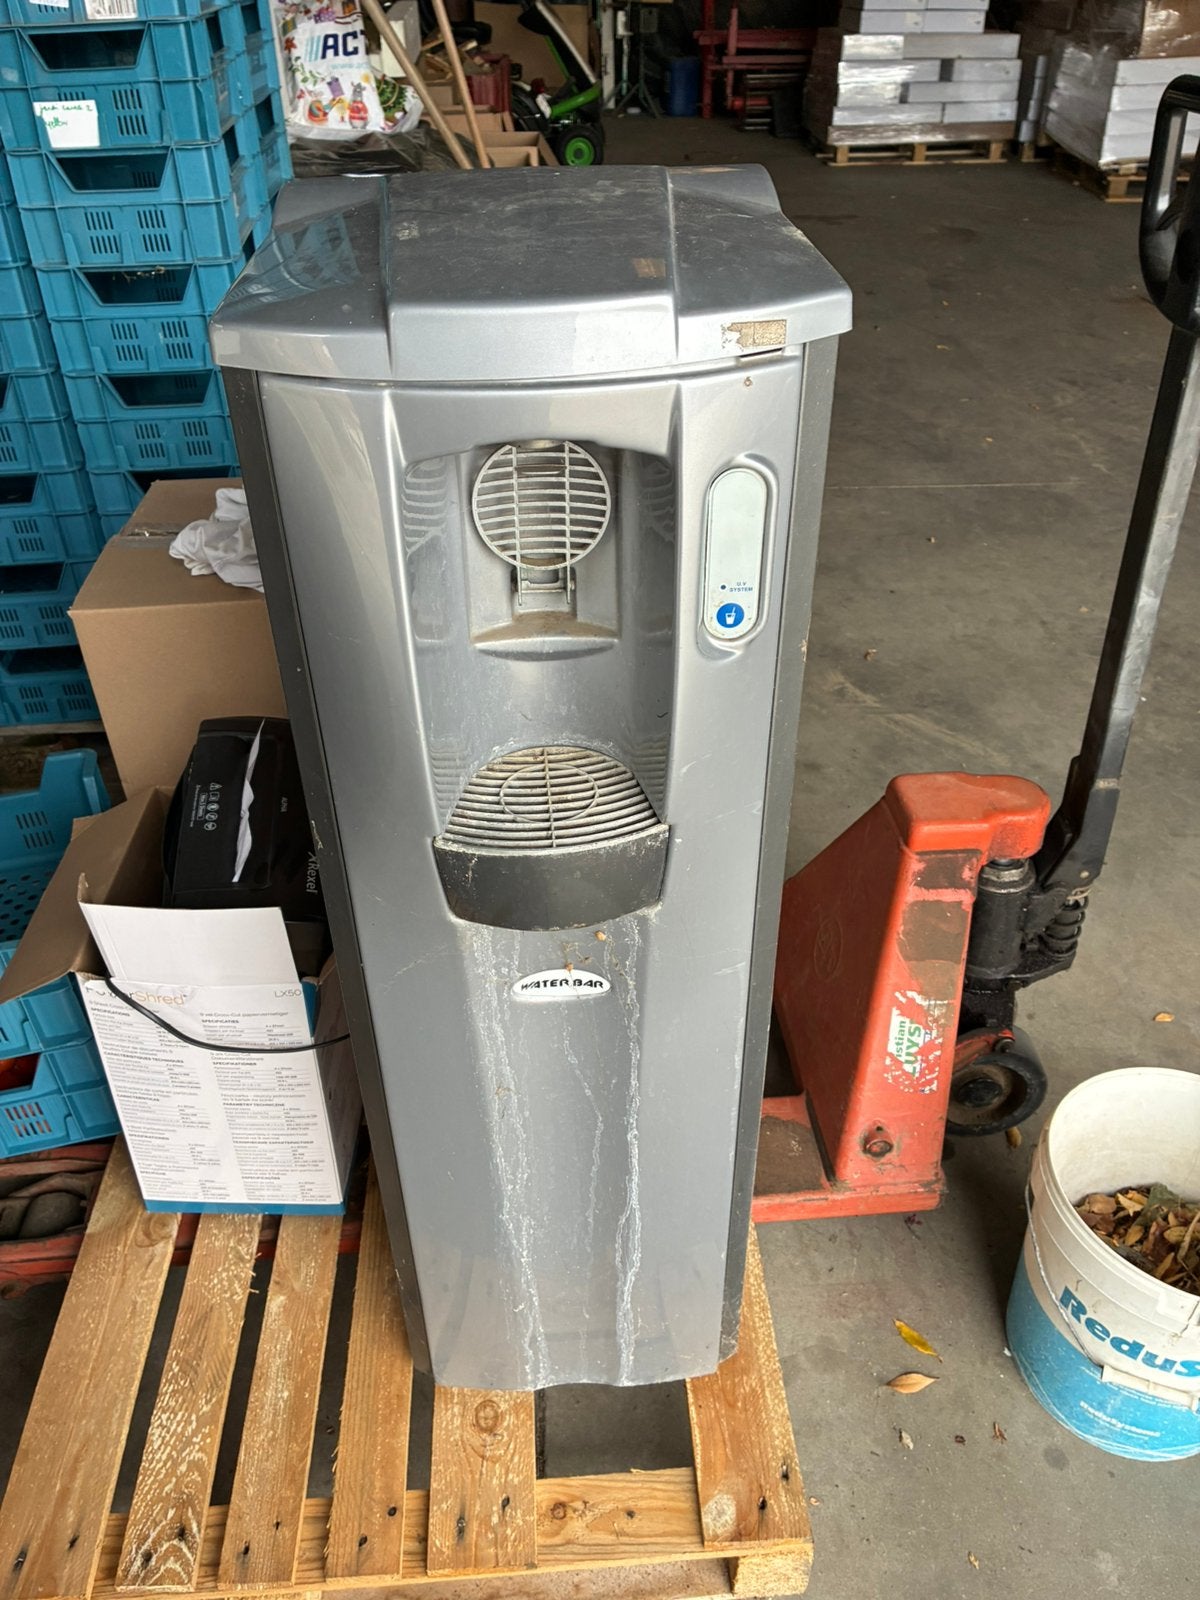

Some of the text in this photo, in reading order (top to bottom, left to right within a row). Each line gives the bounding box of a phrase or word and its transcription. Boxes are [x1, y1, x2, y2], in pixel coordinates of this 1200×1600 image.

[306, 862, 320, 893] Rexel
[521, 978, 604, 991] WATER BAR
[274, 988, 302, 998] LX50
